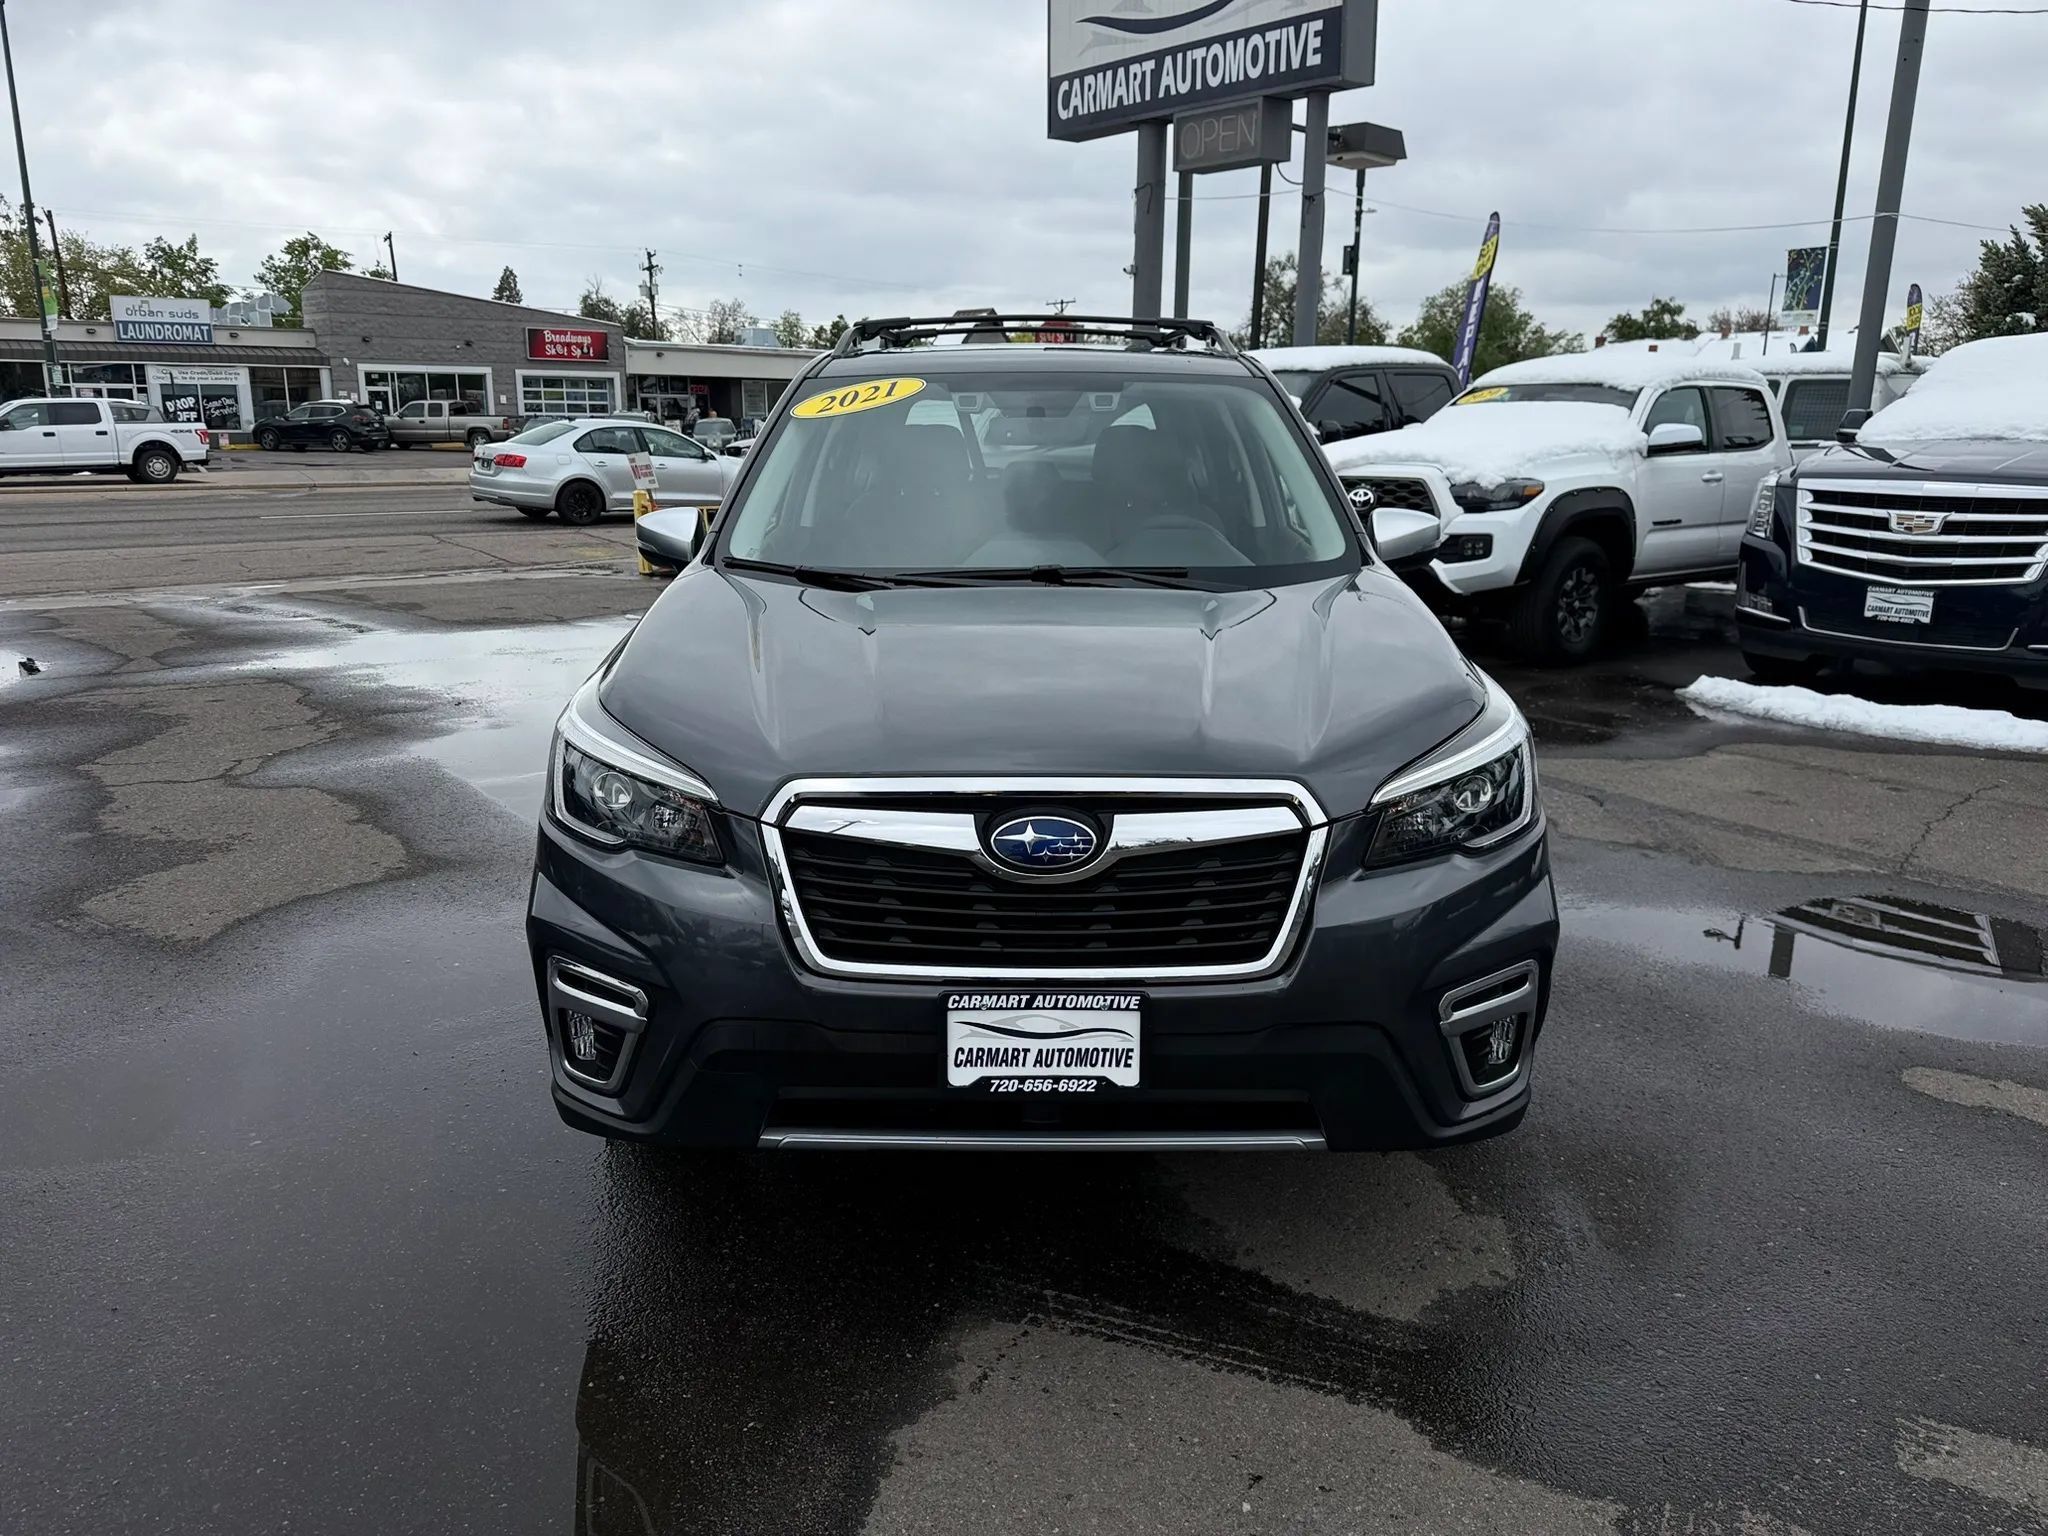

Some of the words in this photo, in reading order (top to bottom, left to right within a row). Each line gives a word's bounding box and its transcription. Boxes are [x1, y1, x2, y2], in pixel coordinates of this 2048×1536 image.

[1057, 59, 1156, 120] CARMART
[1158, 19, 1324, 98] AUTOMOTIVE
[1180, 111, 1257, 159] OPEN
[168, 309, 199, 320] suds
[119, 322, 209, 341] LAUNDROMAT
[543, 330, 592, 344] Broadways
[816, 381, 898, 414] 2021
[1866, 604, 1894, 614] CARMART
[1894, 607, 1930, 618] AUTOMOTIVE
[947, 995, 1030, 1009] CARMART
[1032, 995, 1141, 1009] AUTOMOTIVE
[953, 1047, 1031, 1068] CARMART
[1033, 1047, 1135, 1068] AUTOMOTIVE
[989, 1079, 1098, 1093] 720-656-6922
